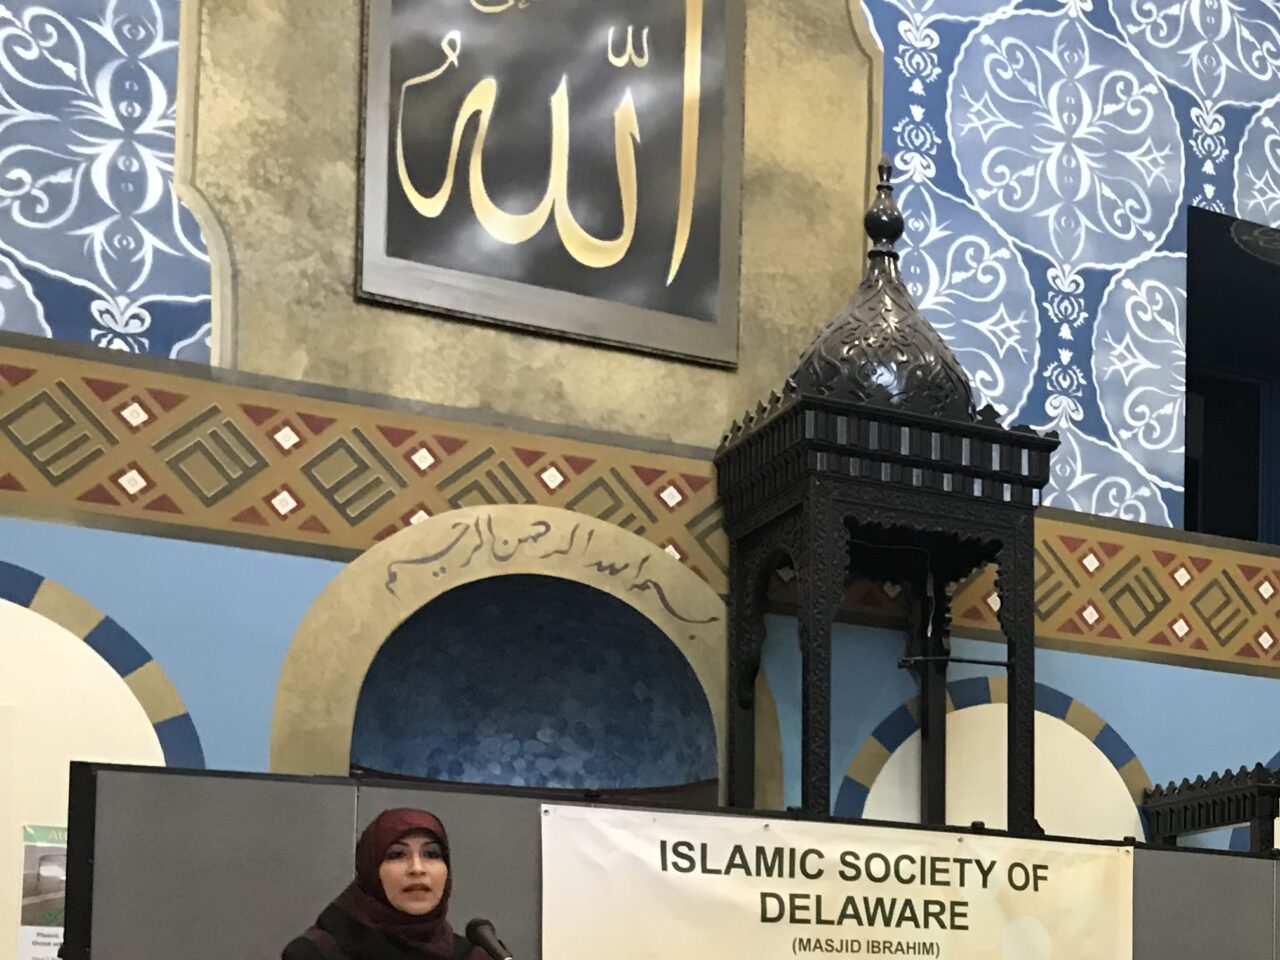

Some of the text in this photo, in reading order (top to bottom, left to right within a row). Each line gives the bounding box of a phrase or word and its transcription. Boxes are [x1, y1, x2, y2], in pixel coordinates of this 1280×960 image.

[659, 839, 1049, 892] ISLAMIC SOCIETY OF
[759, 891, 970, 931] DELAWARE
[791, 937, 941, 960] (MASJID IBRAHIM)
